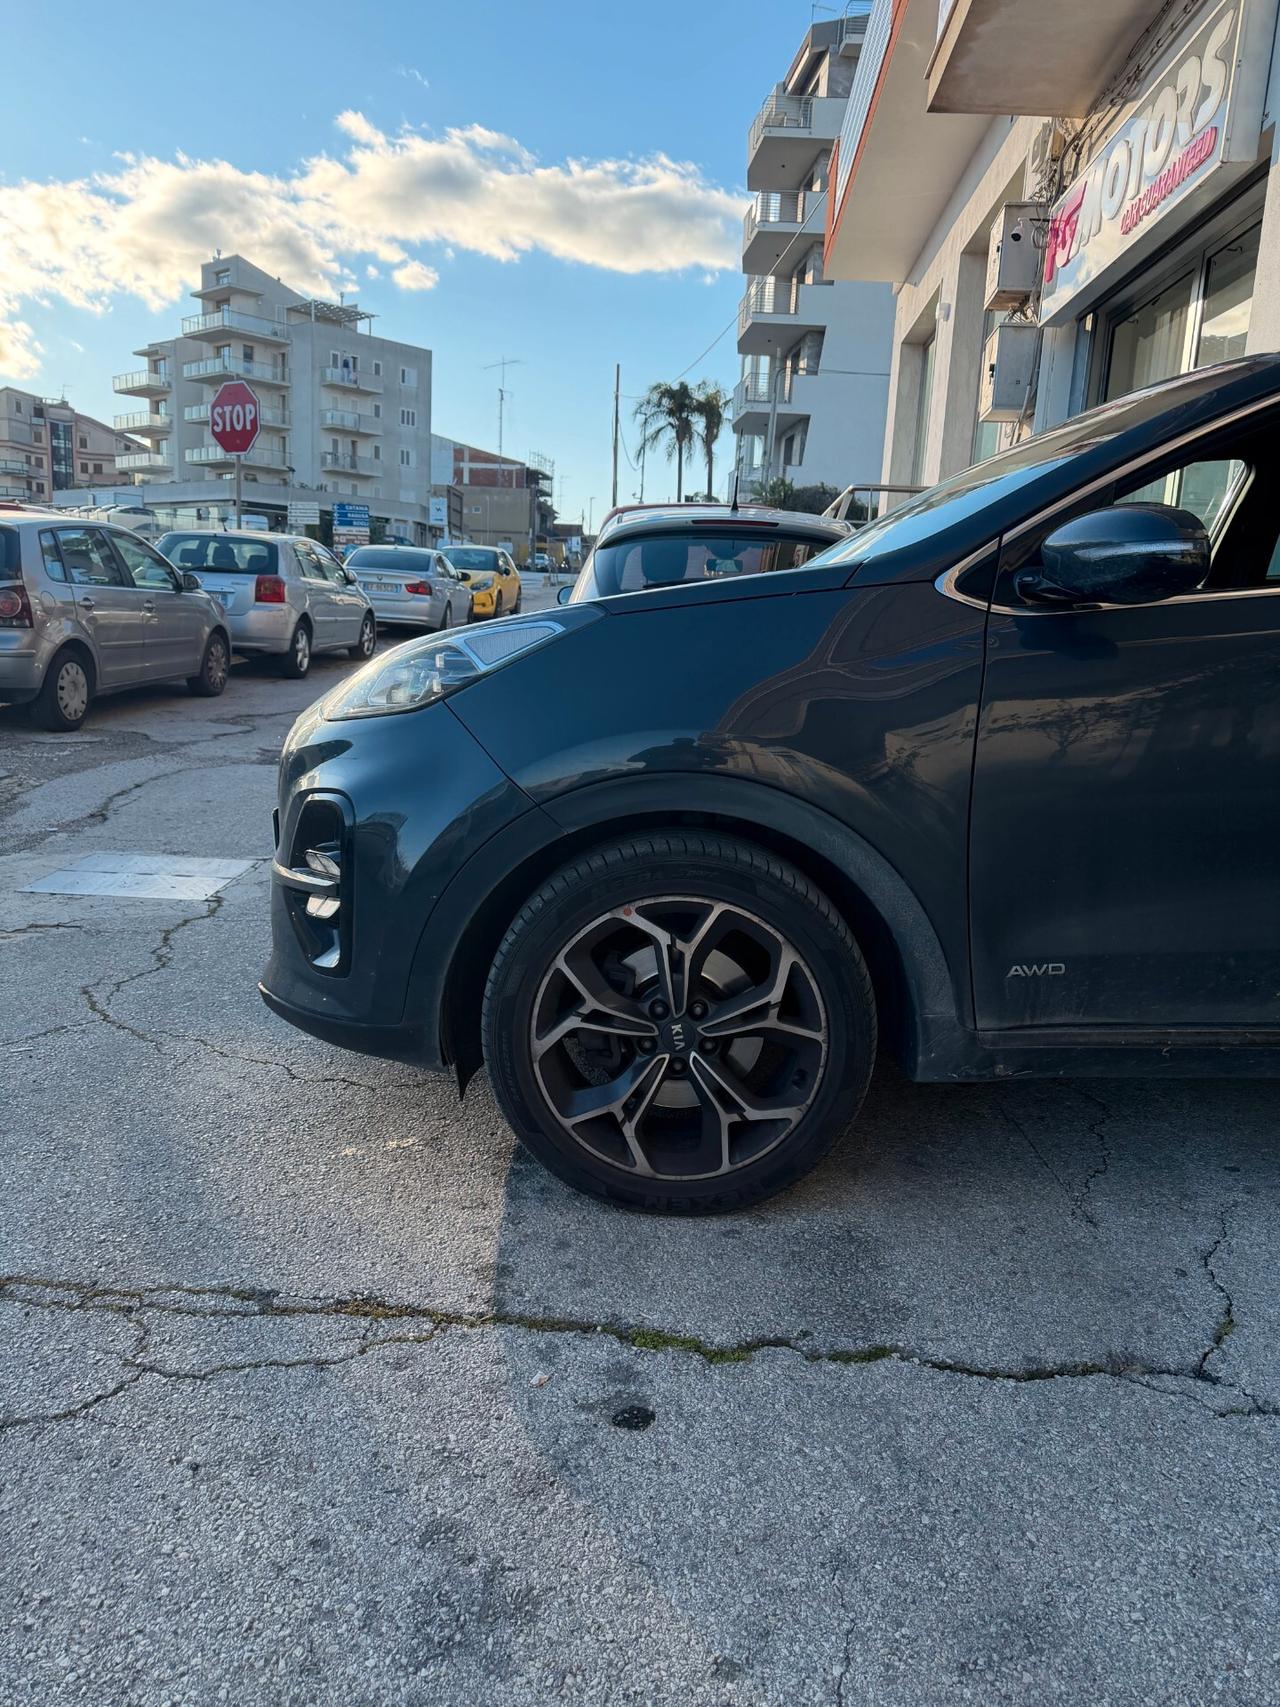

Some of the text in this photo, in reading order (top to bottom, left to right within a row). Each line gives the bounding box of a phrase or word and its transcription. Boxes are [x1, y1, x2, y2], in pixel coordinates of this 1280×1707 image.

[1068, 7, 1238, 260] MOTORS
[212, 403, 256, 432] STOP
[1006, 963, 1066, 978] AWD
[671, 1023, 686, 1050] KIA
